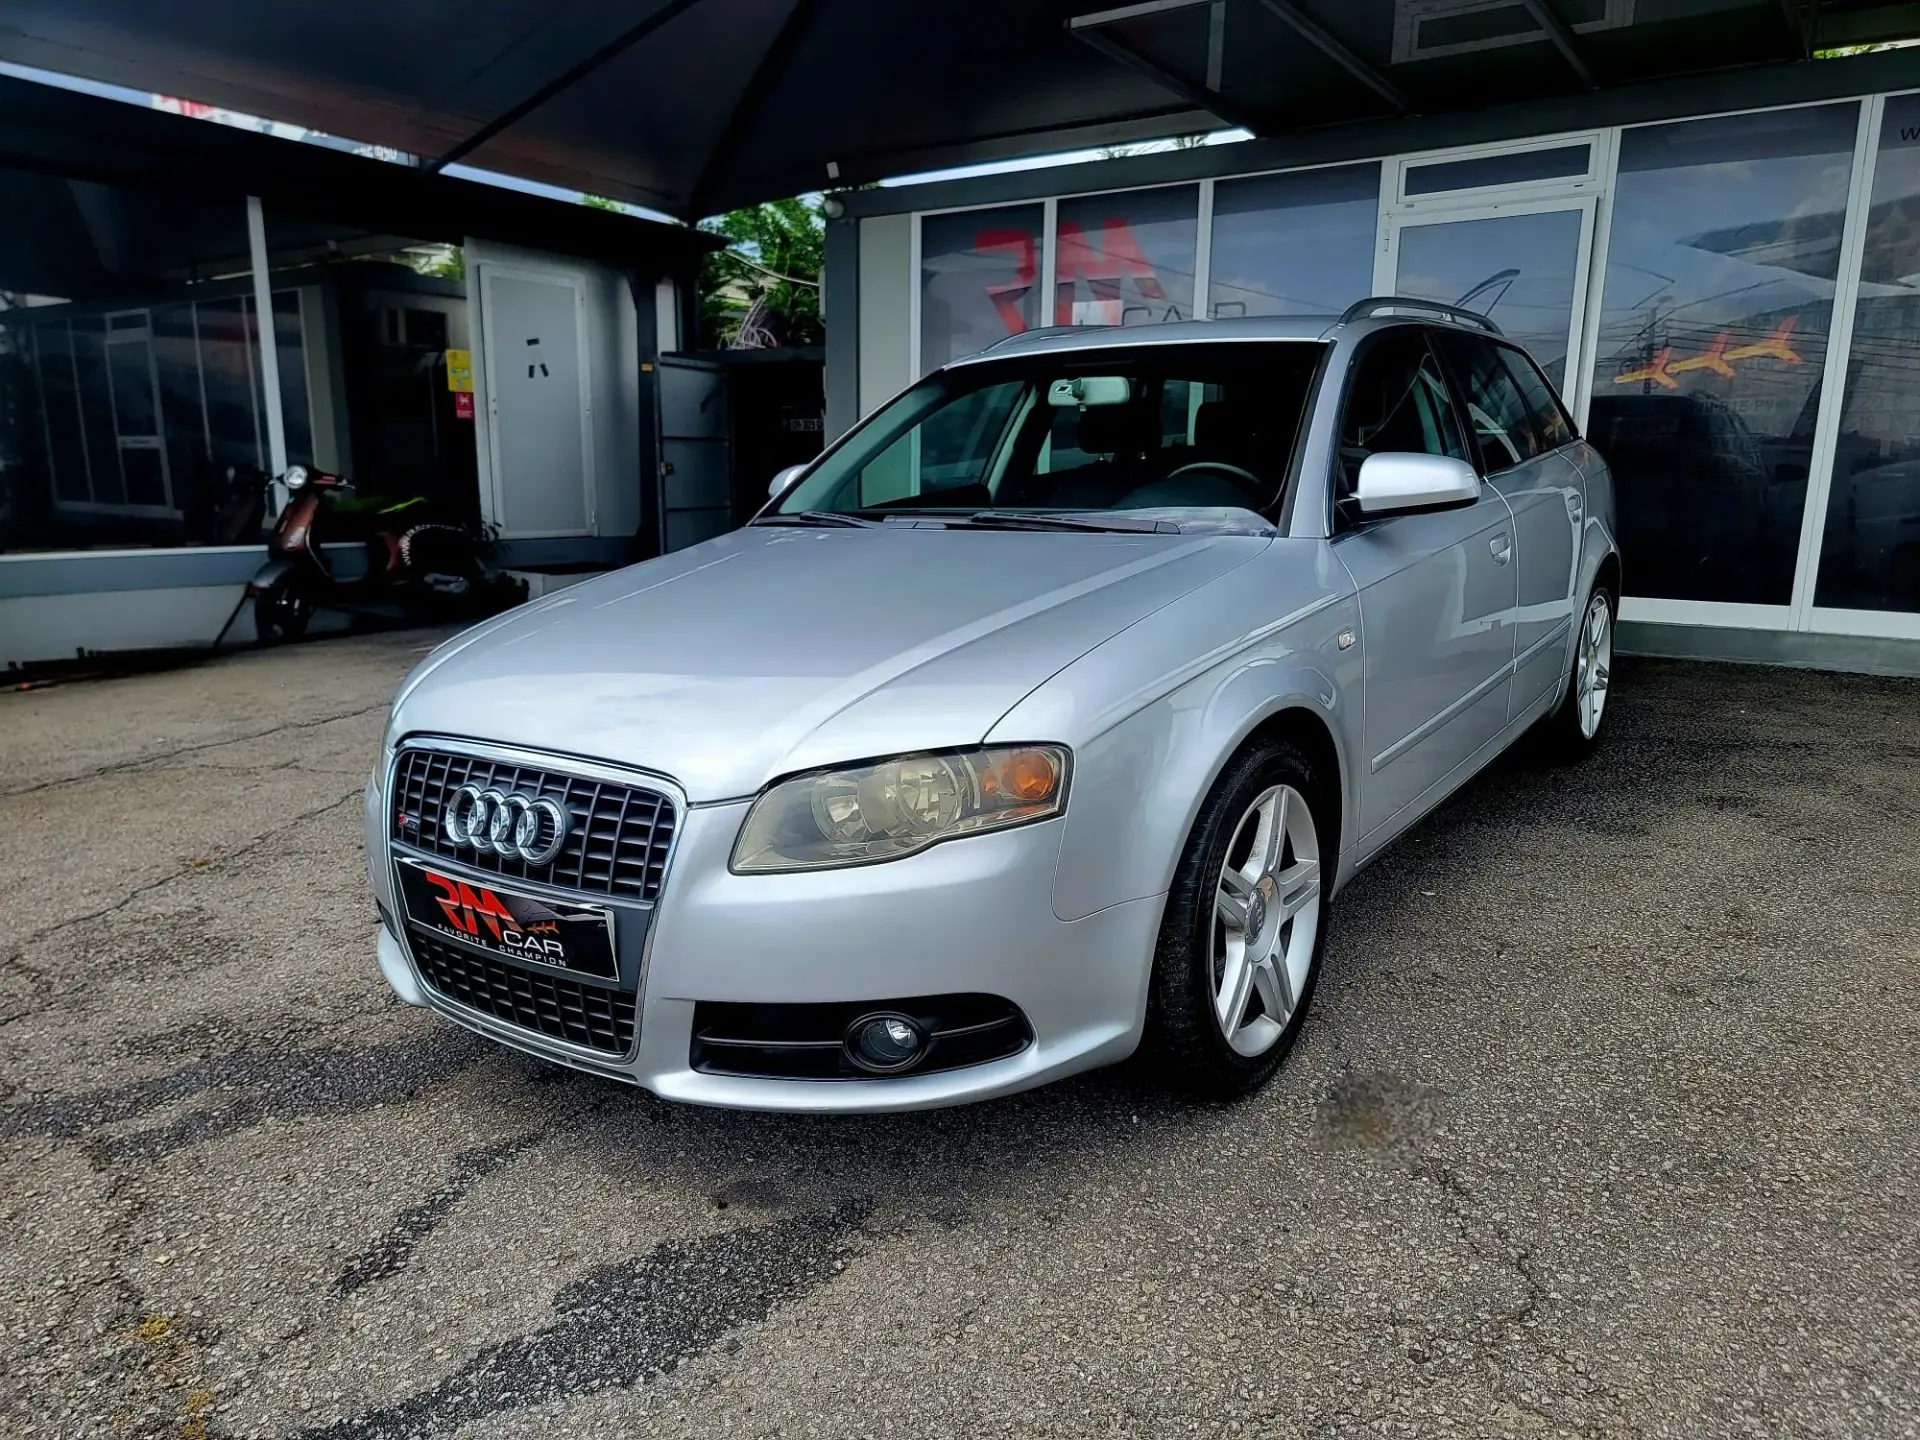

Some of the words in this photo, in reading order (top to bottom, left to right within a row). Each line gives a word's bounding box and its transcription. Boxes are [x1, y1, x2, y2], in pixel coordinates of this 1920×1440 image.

[425, 873, 524, 941] RM
[503, 930, 564, 957] CAR
[437, 923, 488, 947] FAVORITE
[499, 945, 567, 967] CHAMPION
